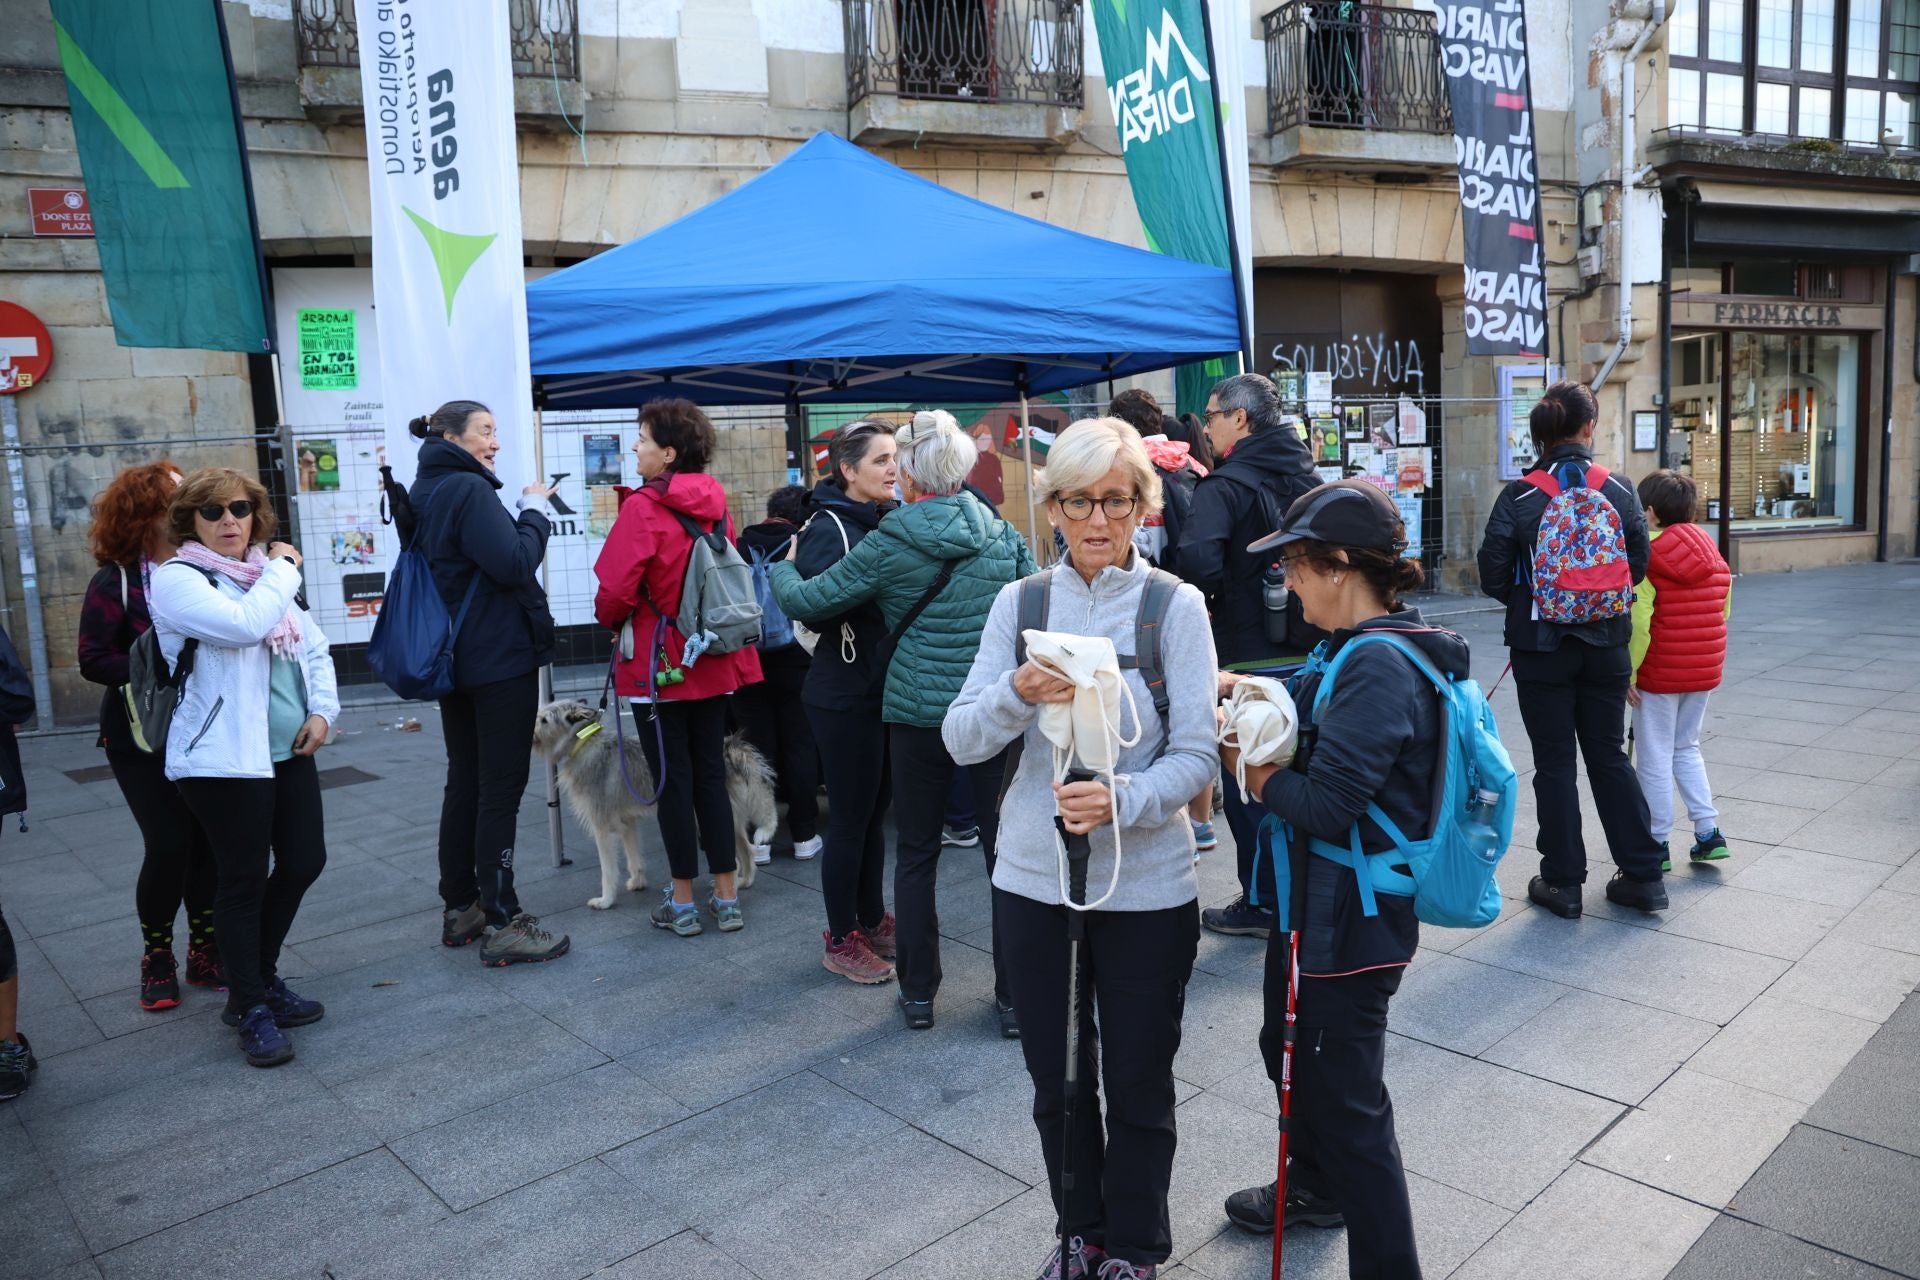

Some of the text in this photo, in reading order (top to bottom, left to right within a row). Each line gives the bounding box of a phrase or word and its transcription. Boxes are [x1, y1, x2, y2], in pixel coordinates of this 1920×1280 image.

[42, 212, 71, 221] DONE
[61, 222, 92, 231] PLAZA
[1715, 303, 1842, 325] FARMACIA
[303, 352, 354, 364] EN TOL
